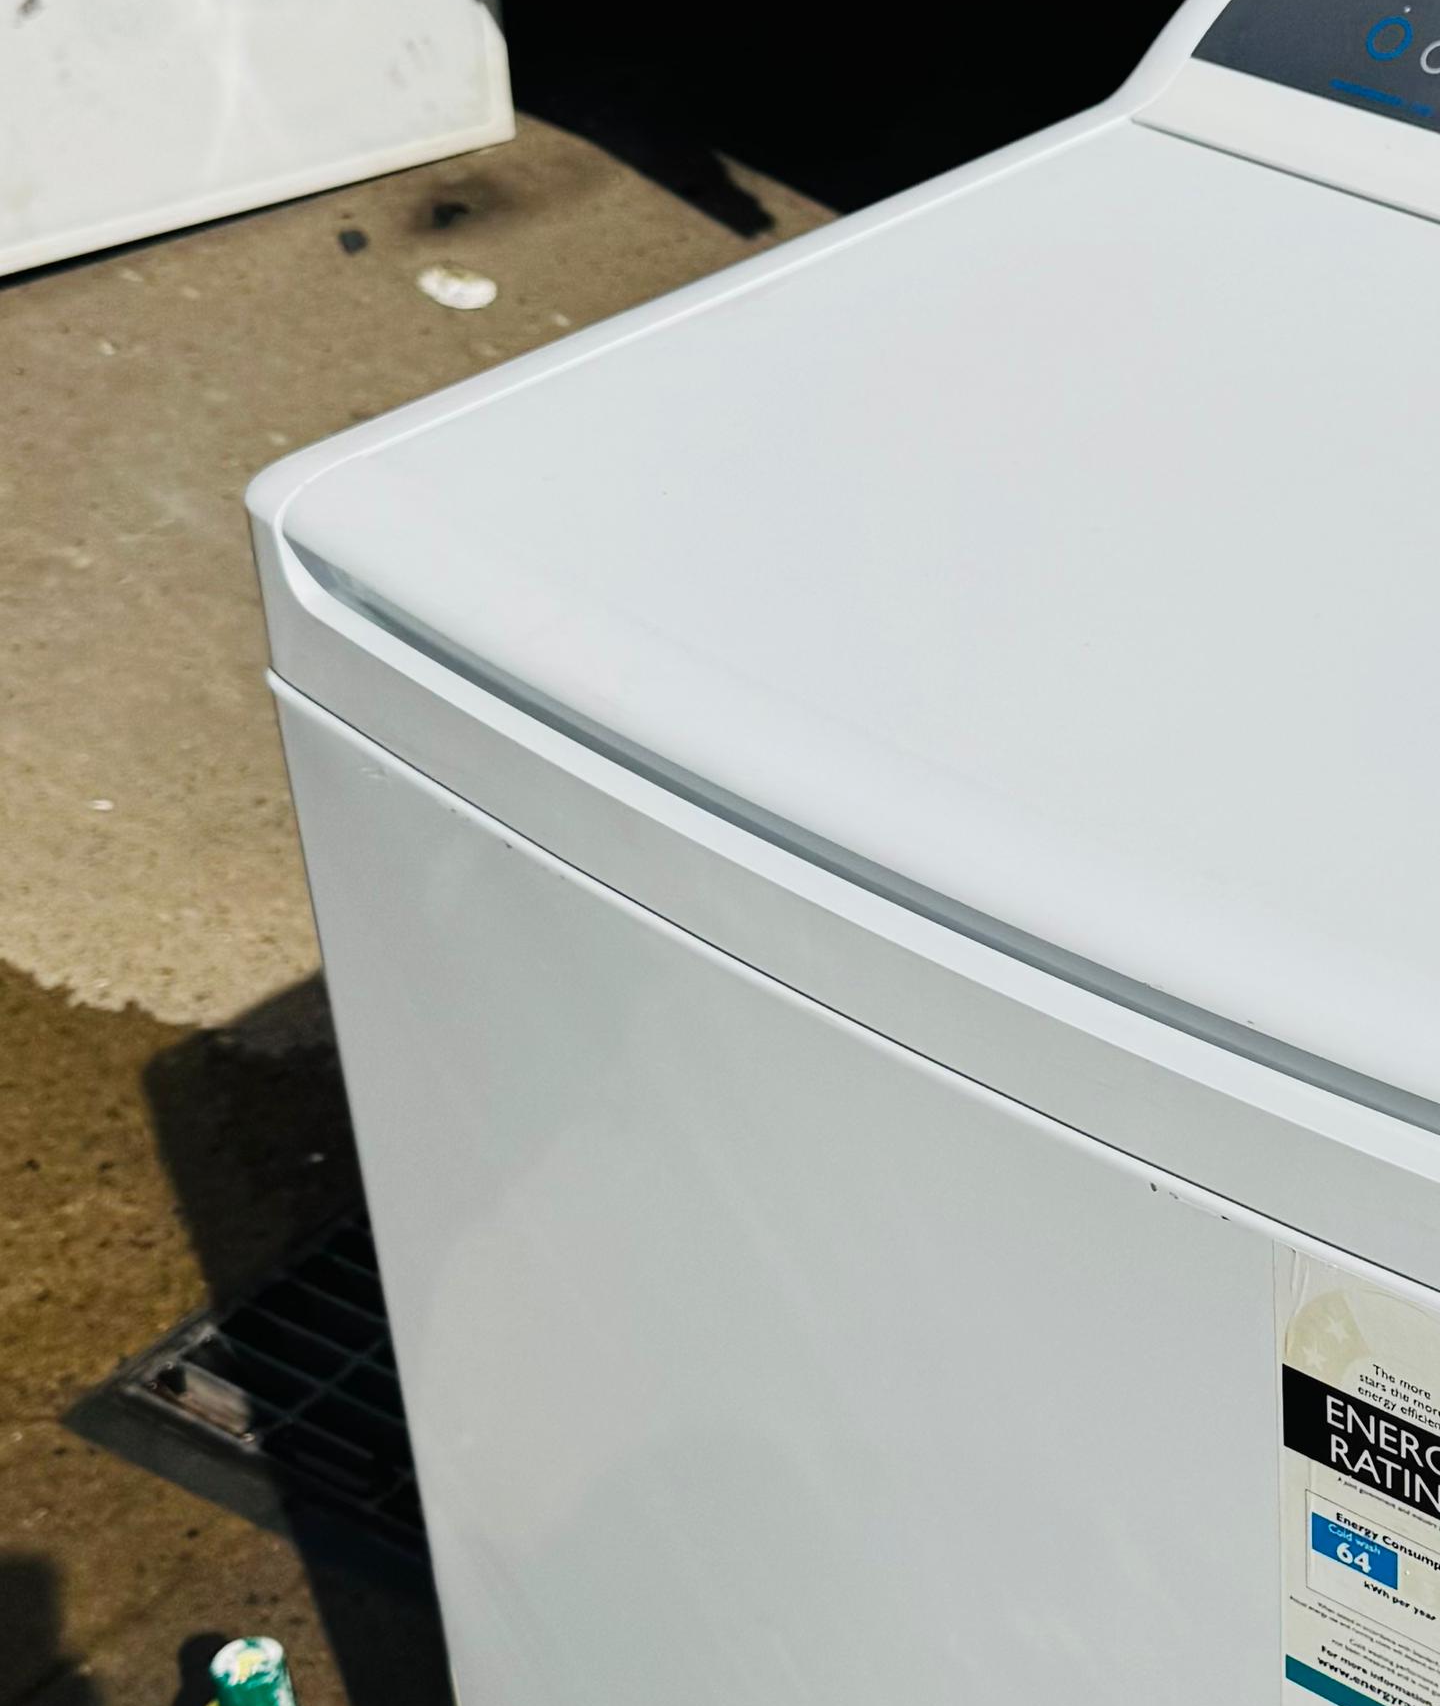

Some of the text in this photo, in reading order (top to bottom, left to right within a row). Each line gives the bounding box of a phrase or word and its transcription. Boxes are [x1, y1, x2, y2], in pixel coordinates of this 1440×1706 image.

[1360, 1374, 1386, 1392] stars
[1390, 1388, 1409, 1403] the
[1372, 1364, 1431, 1400] The more
[1358, 1387, 1396, 1412] energy
[1328, 1523, 1380, 1555] Cold wash
[1336, 1512, 1378, 1541] Energy
[1336, 1542, 1371, 1573] 64
[1364, 1581, 1436, 1621] kWh per year
[1321, 1645, 1337, 1659] For
[1340, 1657, 1367, 1675] more
